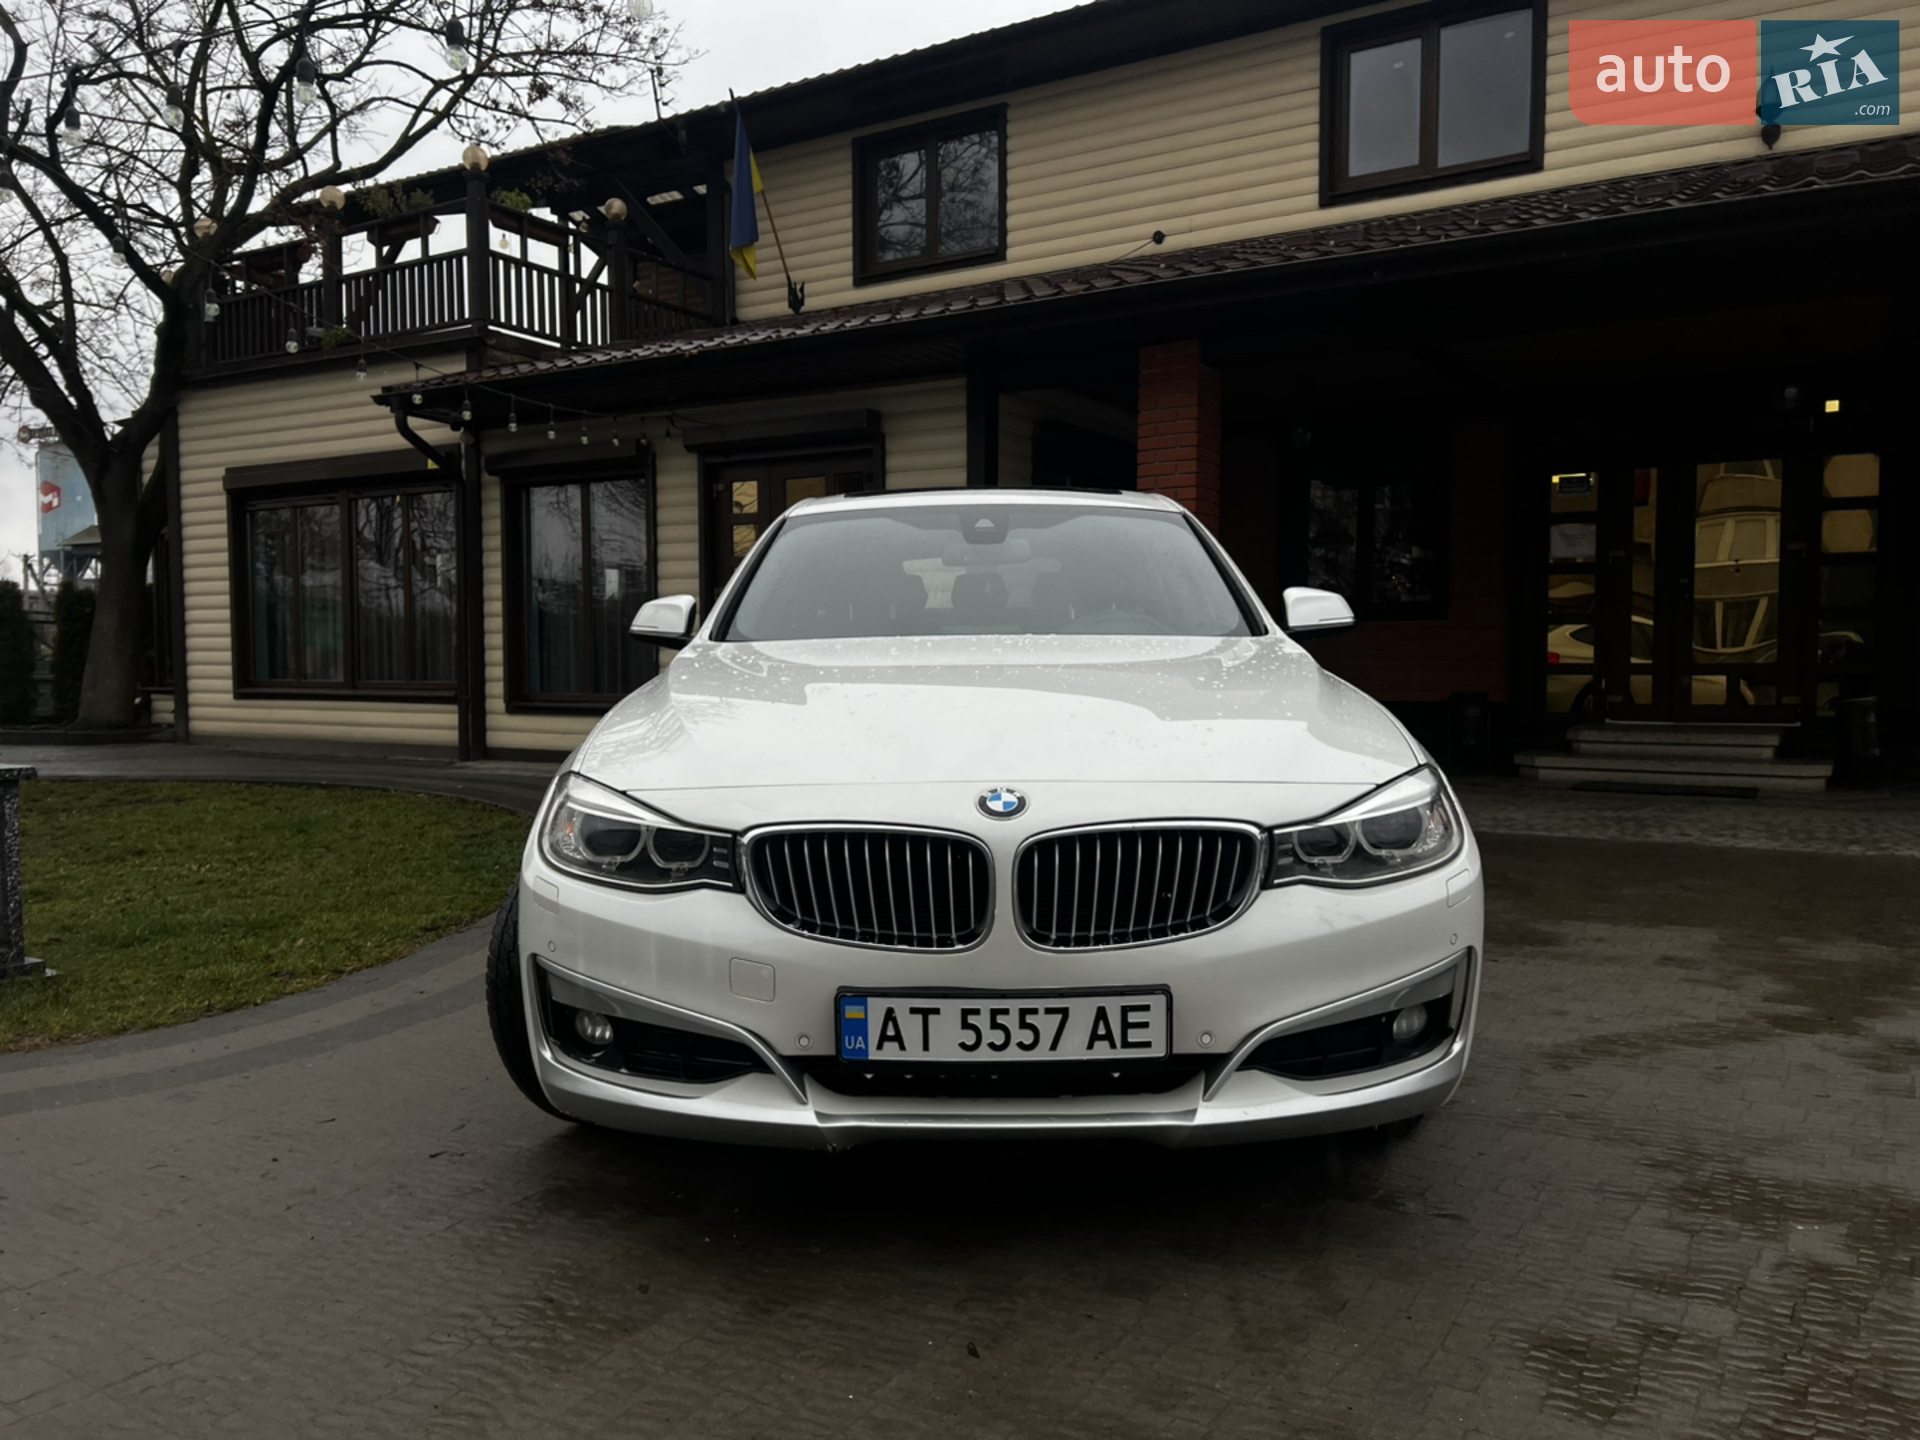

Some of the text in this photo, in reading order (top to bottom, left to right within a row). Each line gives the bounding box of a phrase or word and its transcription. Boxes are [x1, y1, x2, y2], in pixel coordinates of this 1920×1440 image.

[844, 1036, 866, 1050] UA
[875, 1004, 1153, 1052] AT 5557 AE
